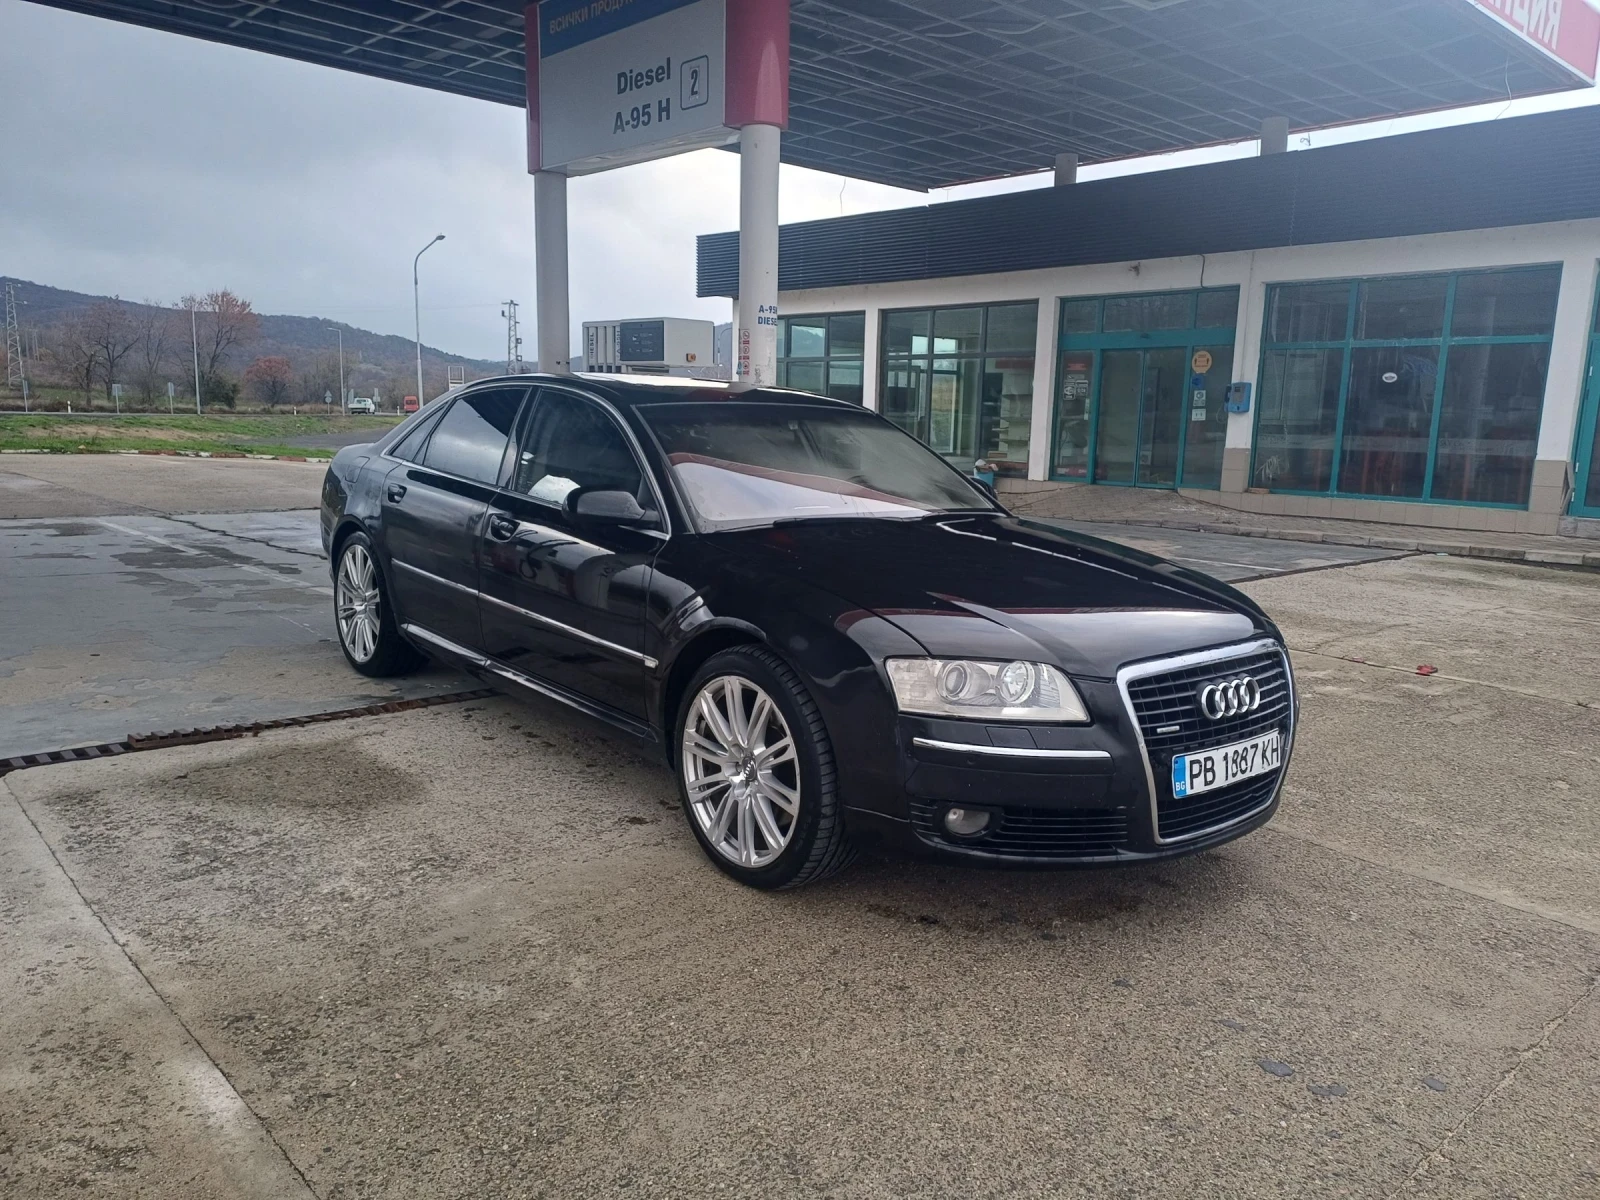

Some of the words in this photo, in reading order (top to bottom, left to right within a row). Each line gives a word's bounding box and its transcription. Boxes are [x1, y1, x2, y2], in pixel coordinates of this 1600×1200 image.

[549, 6, 589, 34] ВСИЧКИ
[617, 57, 671, 95] Diesel
[690, 69, 699, 96] 2
[613, 103, 652, 135] A-95
[657, 98, 671, 123] H
[1189, 755, 1216, 790] PB
[1222, 743, 1259, 781] 1887
[1261, 735, 1280, 767] KH
[1175, 782, 1186, 791] BG
